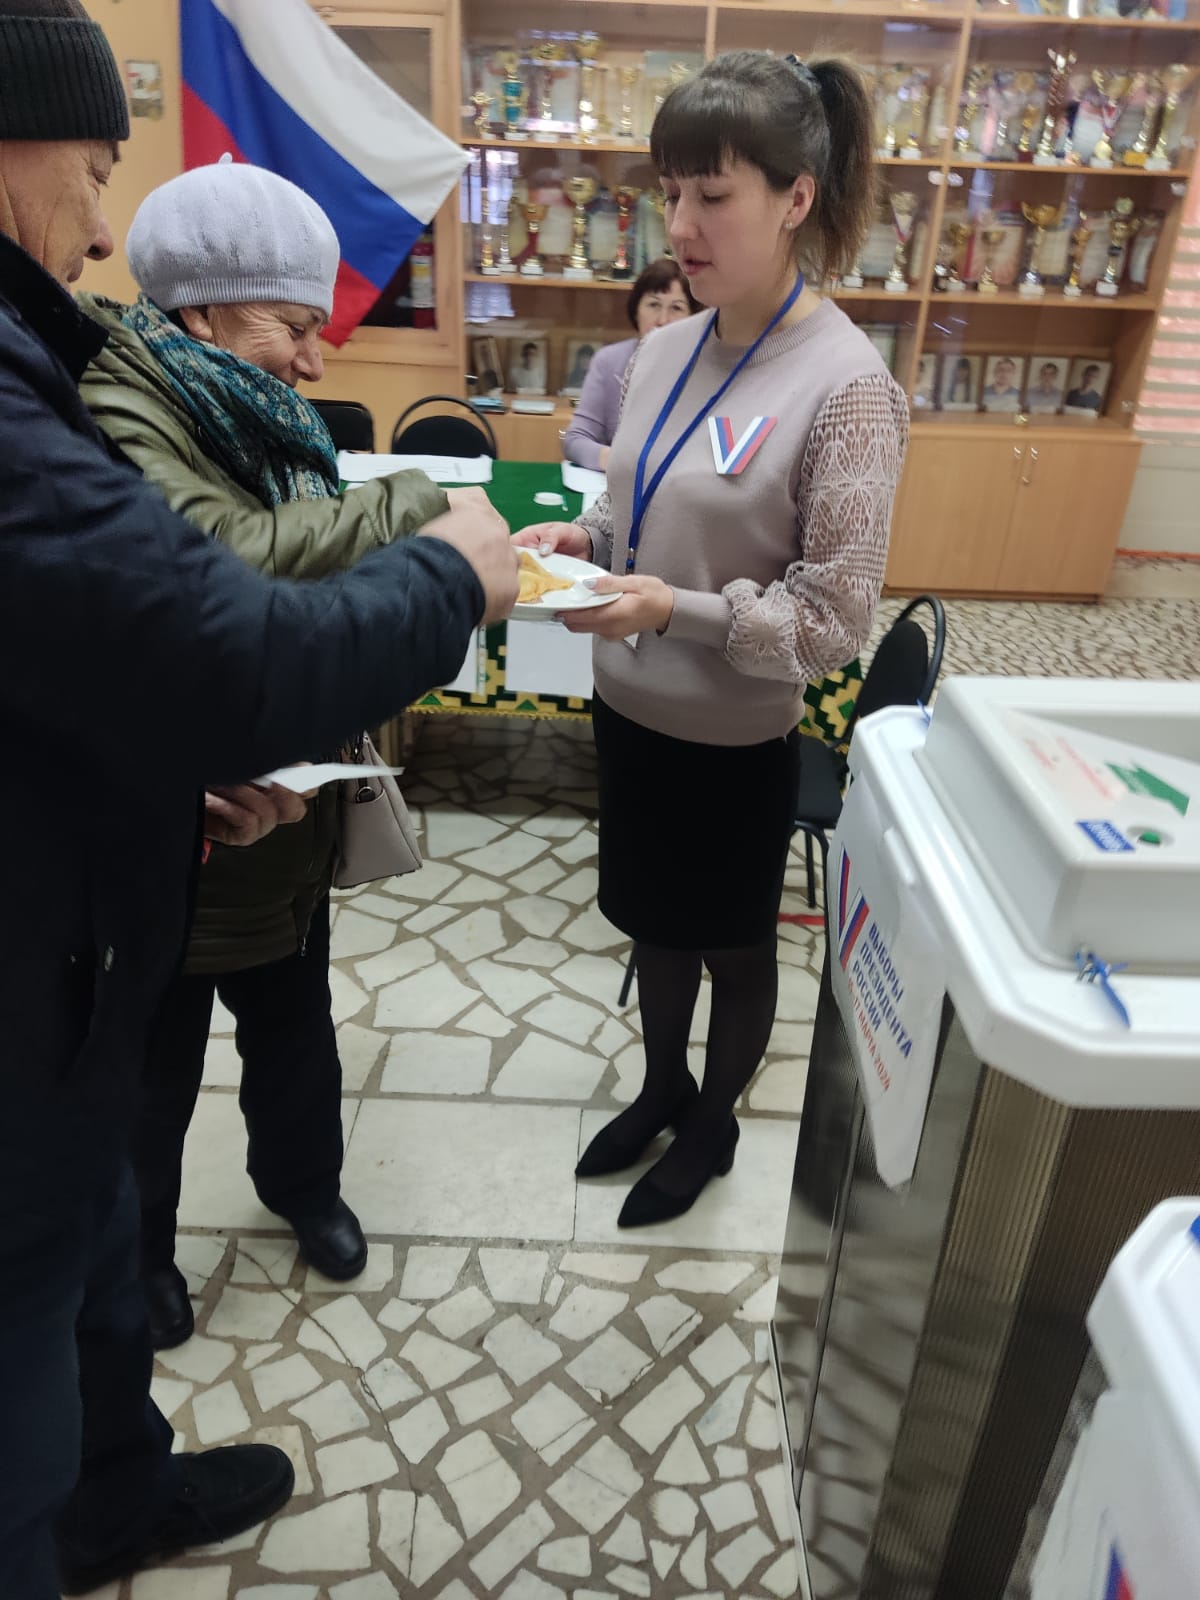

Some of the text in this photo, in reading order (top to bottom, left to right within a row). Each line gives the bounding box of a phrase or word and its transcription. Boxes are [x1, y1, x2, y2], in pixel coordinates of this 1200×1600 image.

[852, 960, 881, 1032] РОССИИ
[860, 941, 913, 1058] ПРЕЗИДЕНТА
[868, 922, 904, 1003] ВЫБОРЫ
